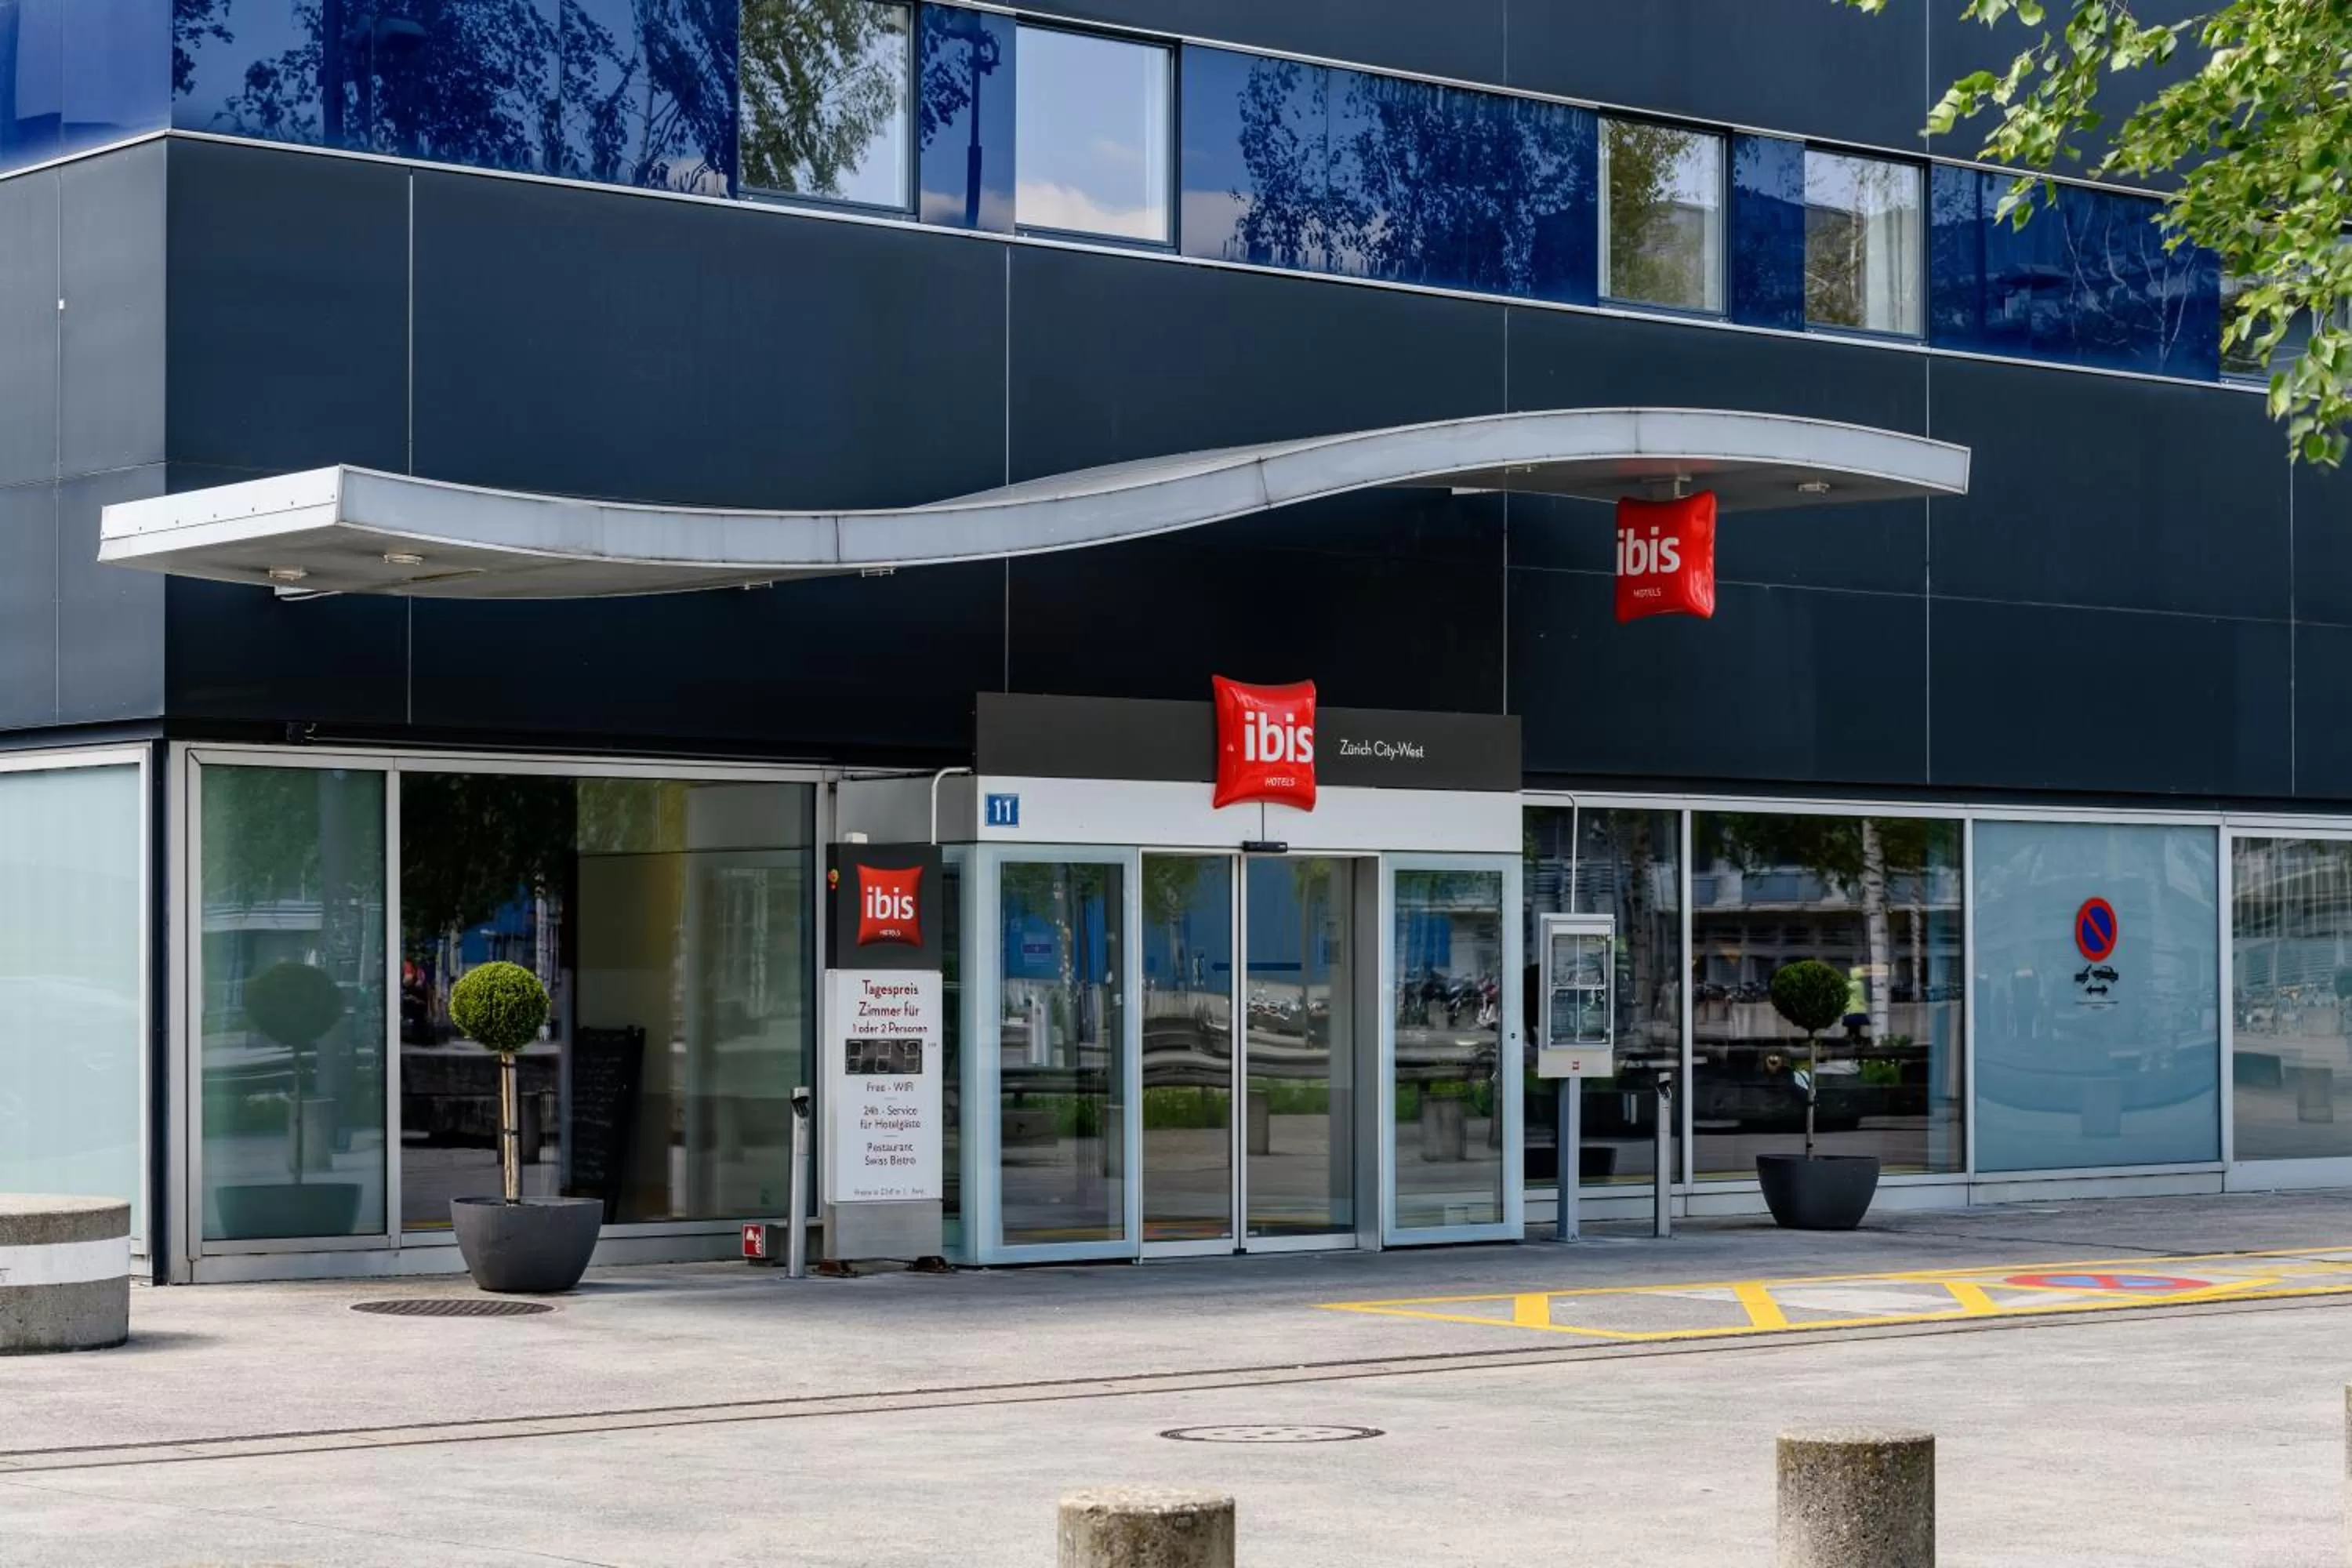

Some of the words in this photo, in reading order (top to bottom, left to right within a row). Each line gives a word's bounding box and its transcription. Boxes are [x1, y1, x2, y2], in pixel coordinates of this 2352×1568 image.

[1617, 526, 1681, 576] ibis
[1633, 587, 1661, 598] HOTELS
[1244, 711, 1313, 764] ibis
[1340, 739, 1372, 756] Zürich
[1374, 740, 1424, 761] City-West
[1265, 777, 1296, 787] HOTELS
[994, 800, 1011, 822] 11
[866, 885, 914, 920] ibis
[862, 979, 919, 999] Tagespreis
[858, 1001, 901, 1017] Zimmer
[904, 1001, 920, 1016] für
[858, 1022, 878, 1033] oder
[880, 1023, 887, 1033] 2
[887, 1105, 919, 1116] Service
